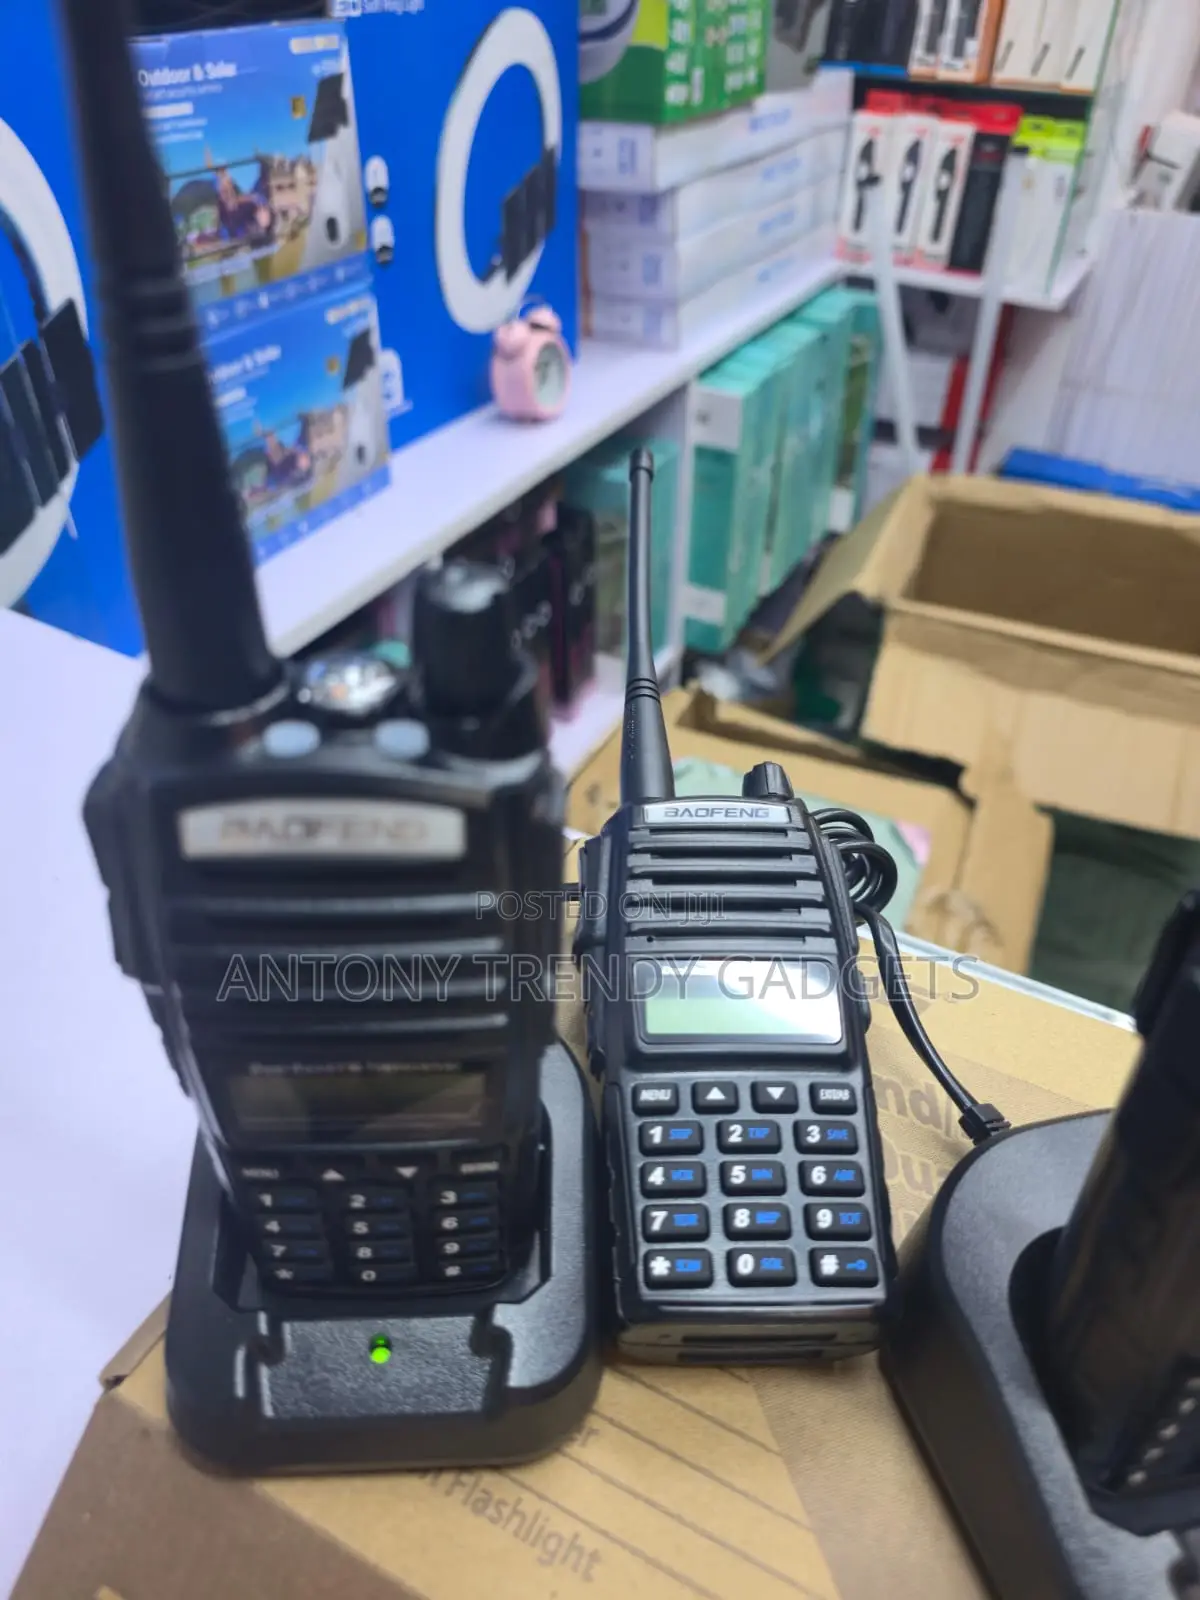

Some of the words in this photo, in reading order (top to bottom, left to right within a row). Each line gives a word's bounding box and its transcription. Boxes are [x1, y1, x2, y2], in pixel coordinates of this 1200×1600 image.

[664, 807, 770, 819] BAOFENG
[649, 1125, 663, 1144] 1
[728, 1123, 743, 1143] 2
[806, 1124, 821, 1143] 3
[648, 1166, 665, 1186] 4
[730, 1165, 746, 1185] 5
[811, 1165, 826, 1185] 6
[650, 1210, 668, 1232] 7
[734, 1208, 750, 1229] 8
[816, 1208, 832, 1229] 9
[737, 1253, 754, 1275] 0
[444, 1469, 602, 1582] Flashlight
